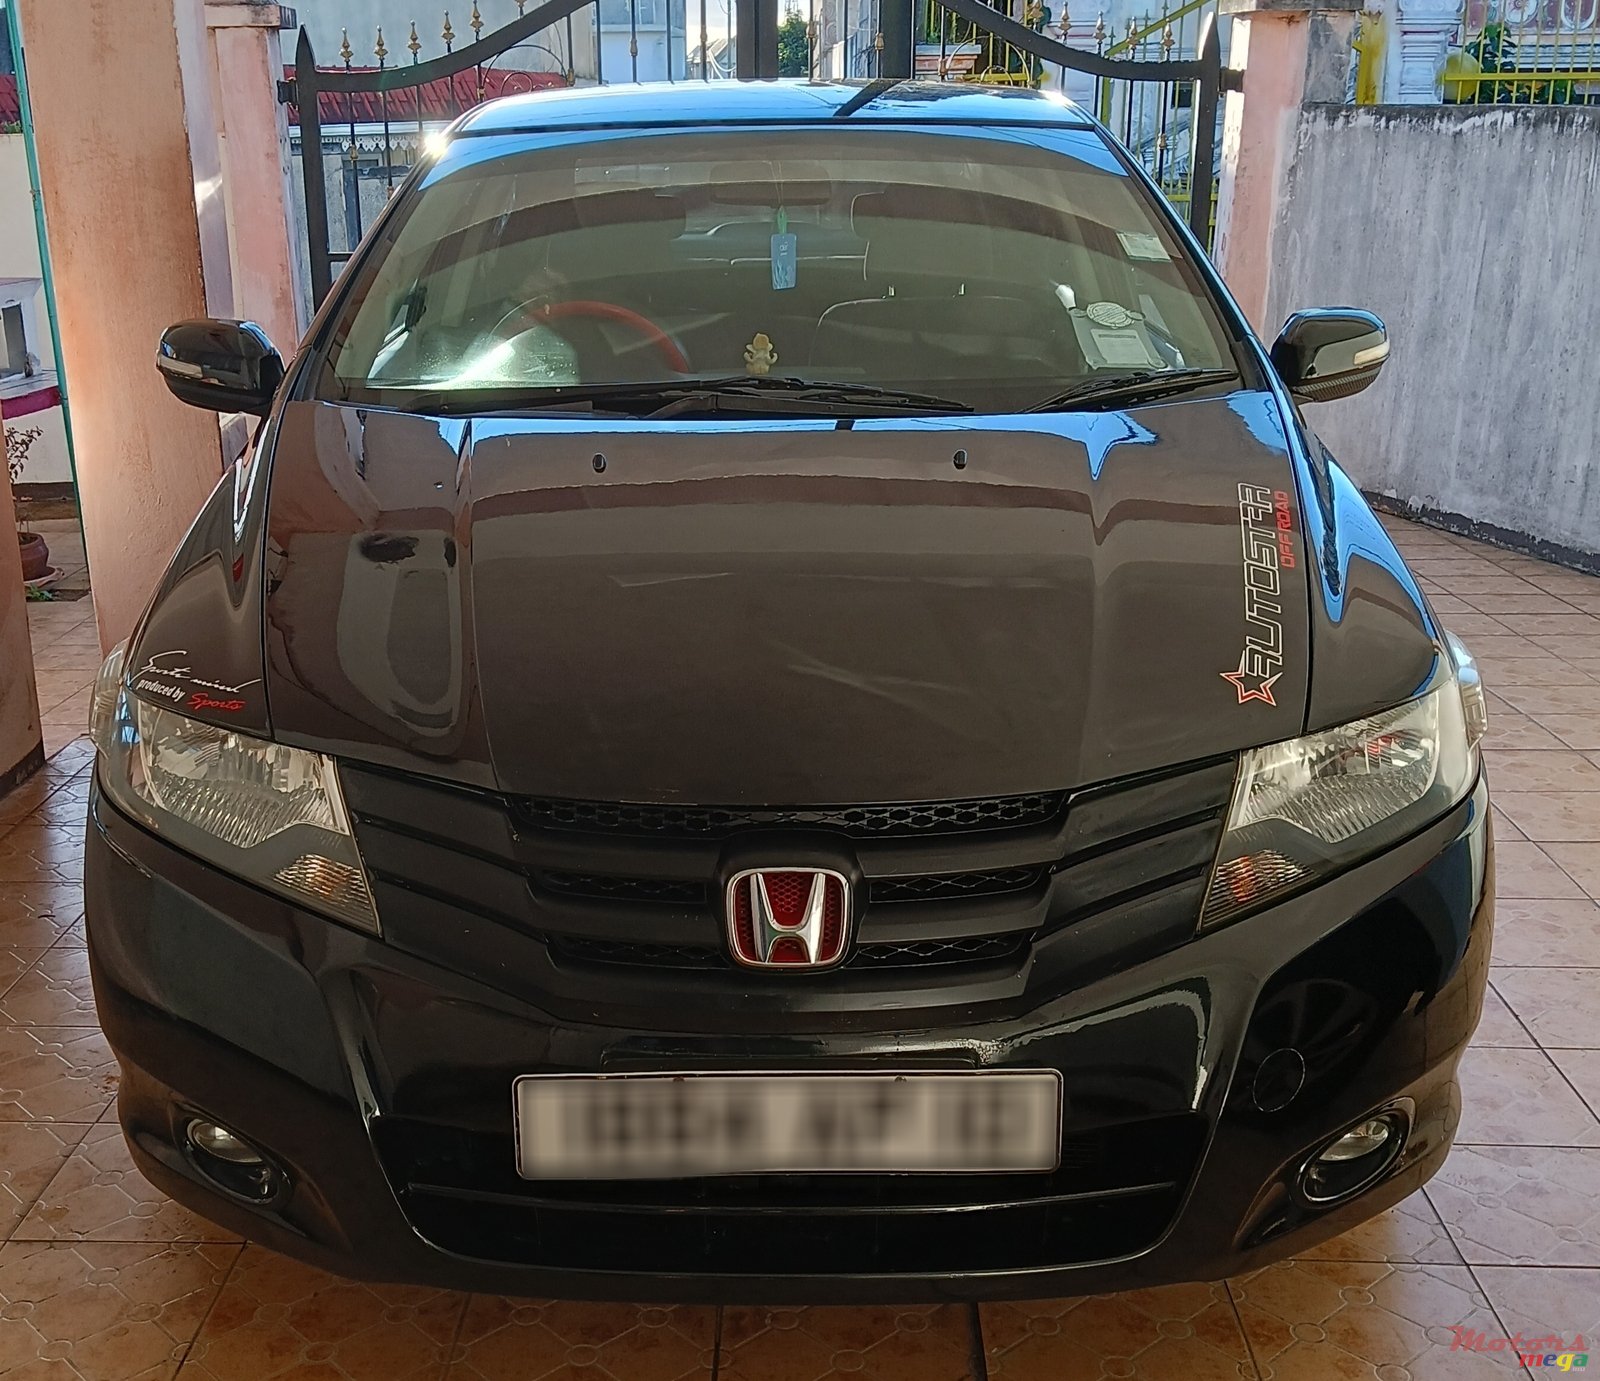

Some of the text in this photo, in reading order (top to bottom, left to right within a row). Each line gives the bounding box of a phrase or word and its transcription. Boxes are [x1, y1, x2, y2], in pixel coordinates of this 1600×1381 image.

[1274, 490, 1296, 568] OFF ROAD
[1238, 482, 1283, 679] AUTOSTAR
[136, 677, 186, 702] produced by
[187, 692, 246, 711] Sports
